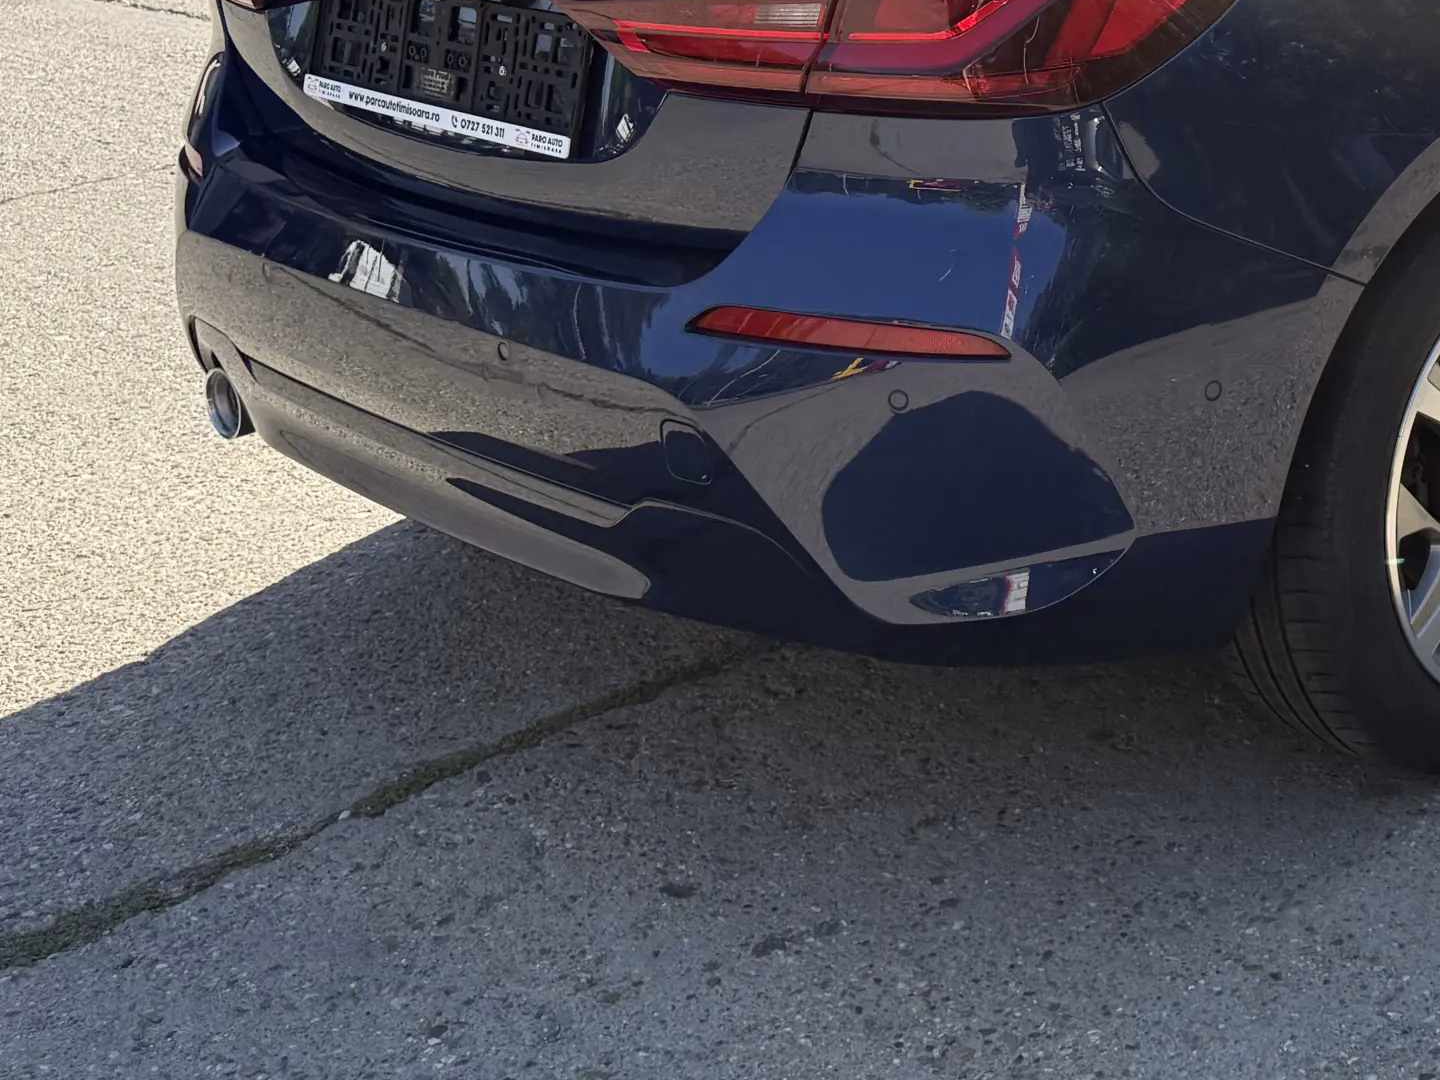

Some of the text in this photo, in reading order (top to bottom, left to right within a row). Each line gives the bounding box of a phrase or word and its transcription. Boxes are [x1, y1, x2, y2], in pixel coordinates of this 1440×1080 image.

[460, 118, 480, 132] 0727
[481, 123, 494, 137] 521
[547, 137, 563, 148] AUTO
